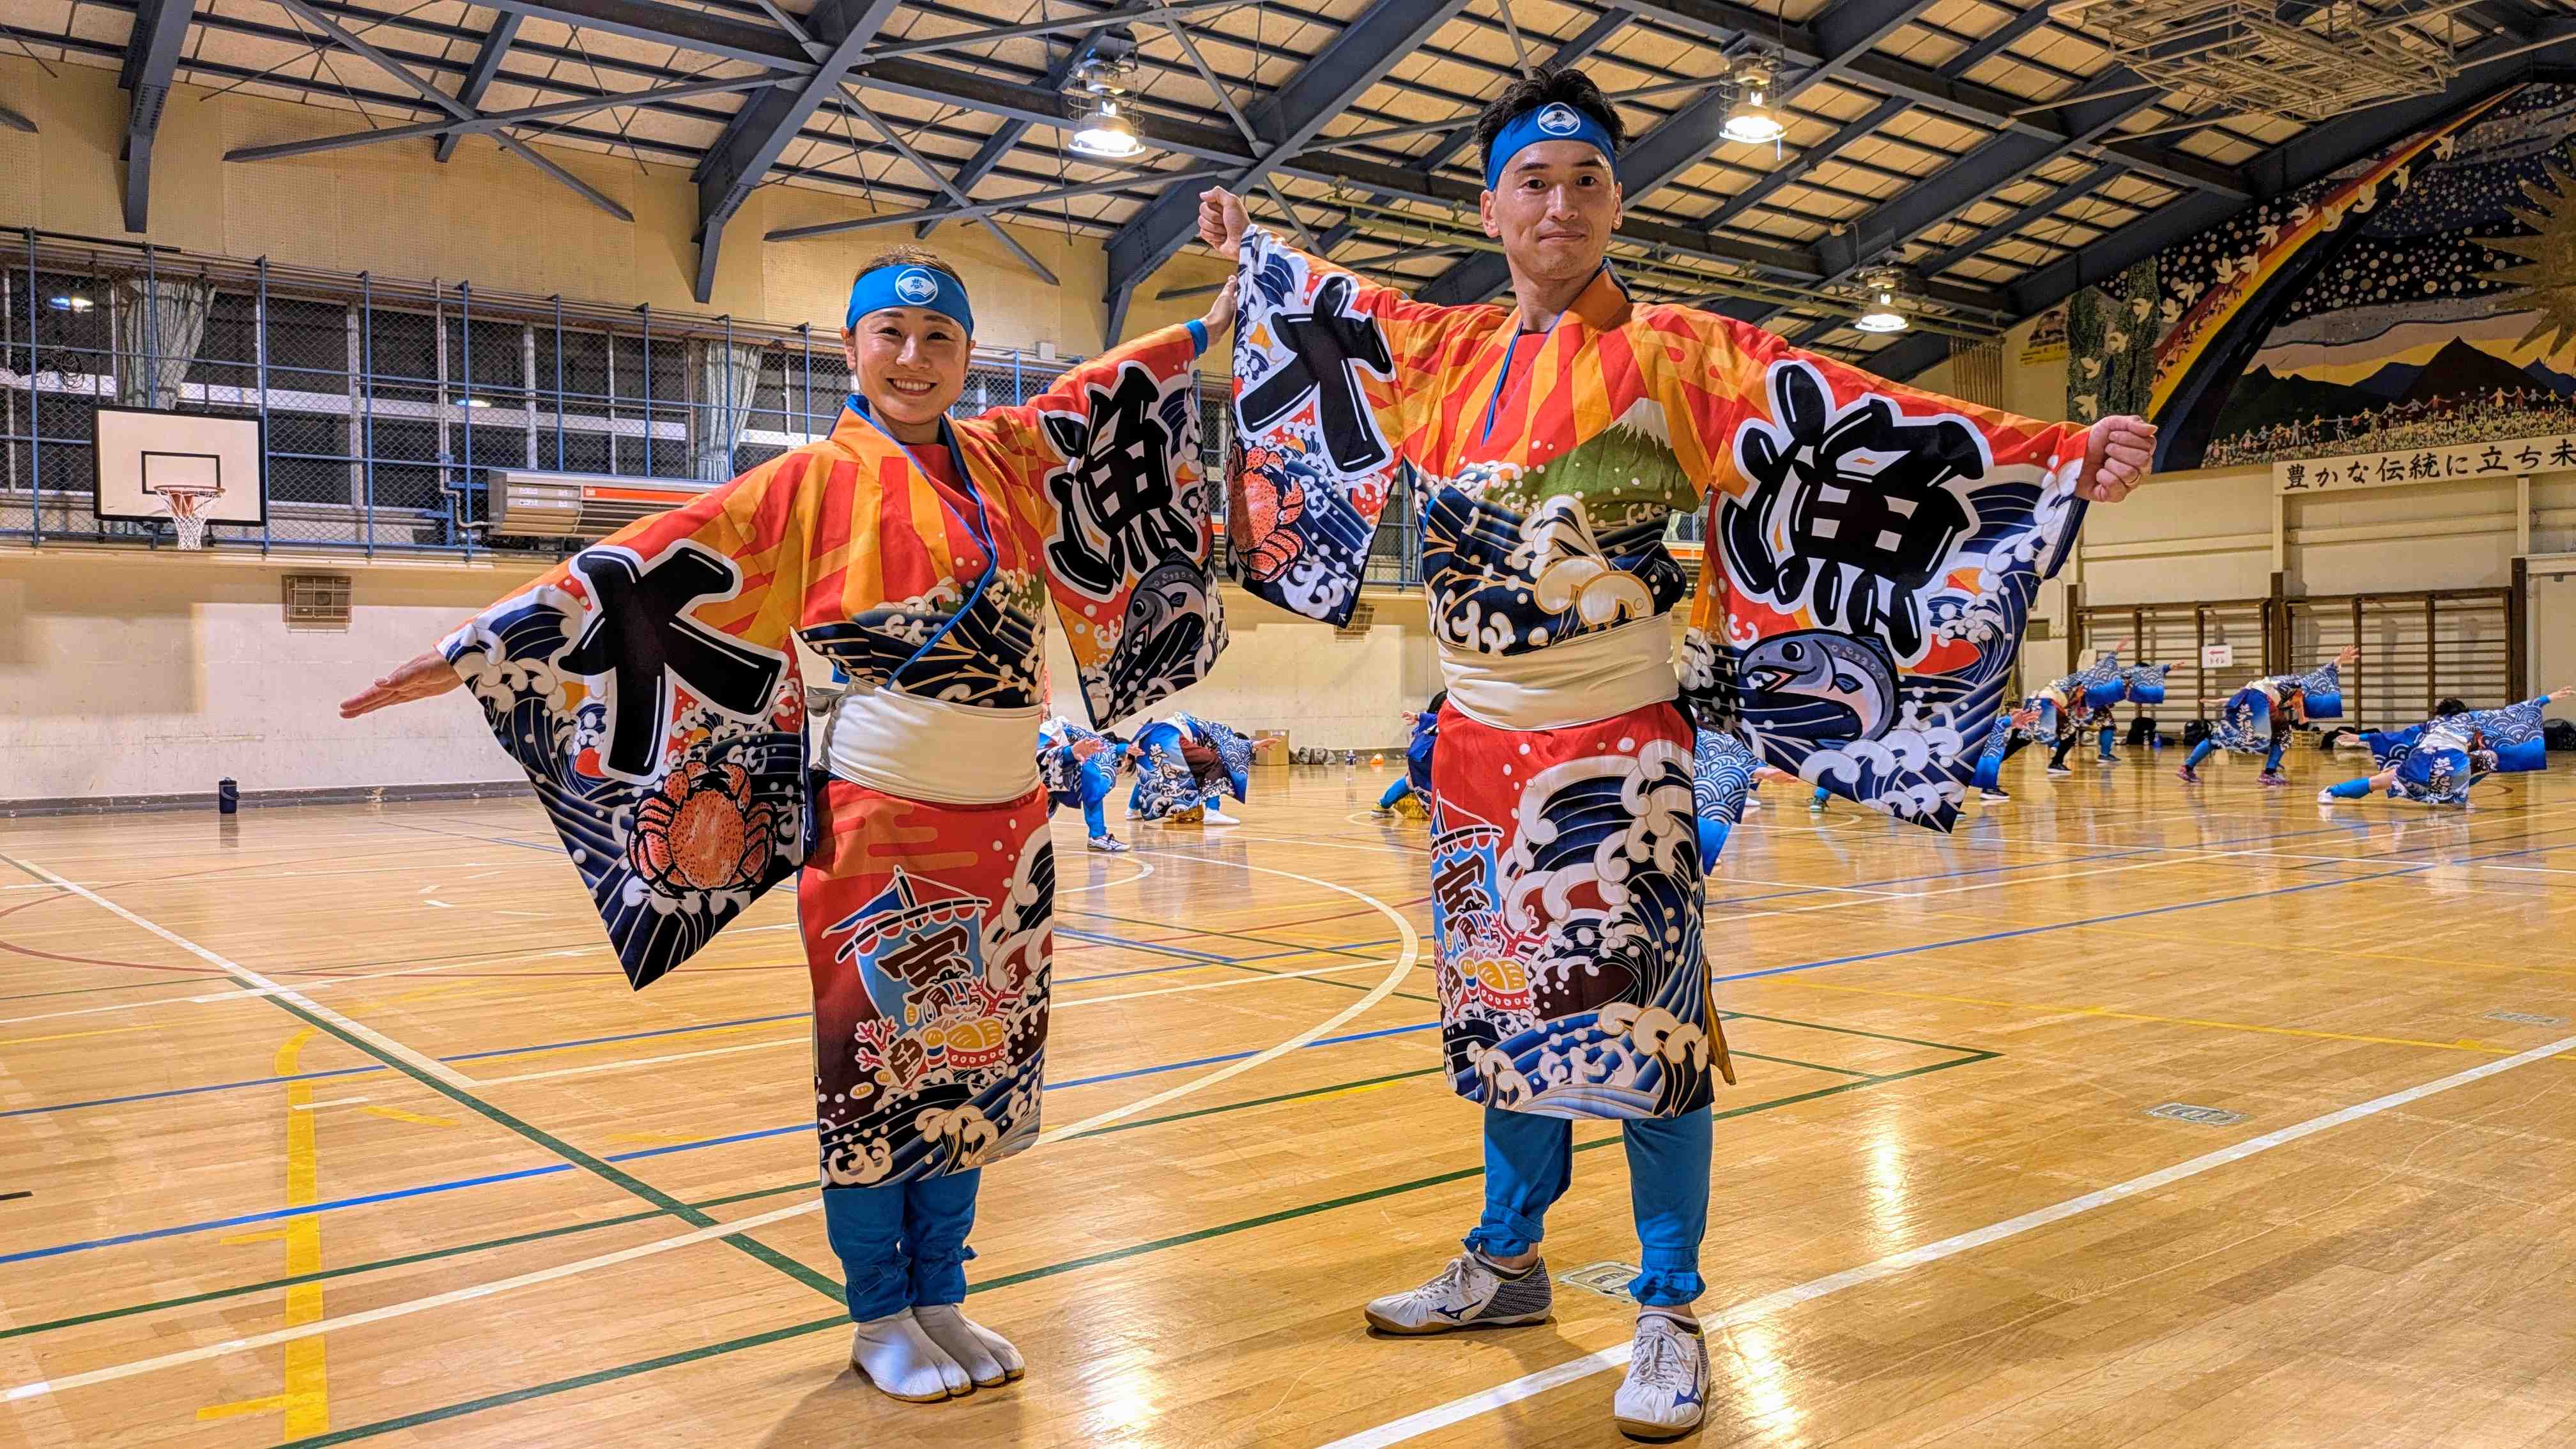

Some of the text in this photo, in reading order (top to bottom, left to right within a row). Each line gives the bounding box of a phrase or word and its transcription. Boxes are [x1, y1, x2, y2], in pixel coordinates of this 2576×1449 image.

[1045, 366, 1197, 595] 漁
[1239, 276, 1394, 474] 大
[2283, 438, 2576, 491] 豊かな伝統に立ち未
[1719, 363, 1984, 659] 漁
[558, 548, 784, 769] 大
